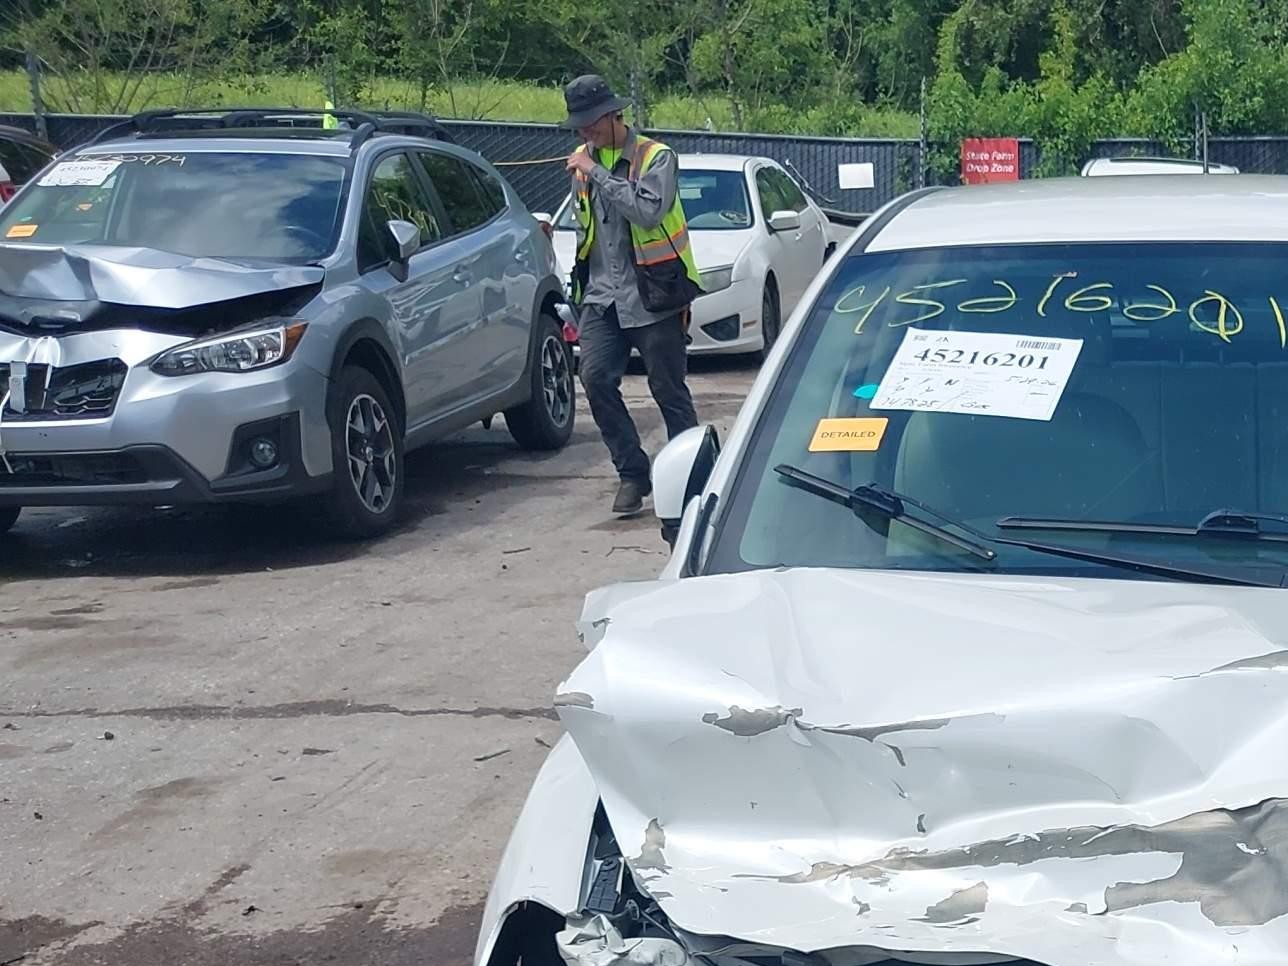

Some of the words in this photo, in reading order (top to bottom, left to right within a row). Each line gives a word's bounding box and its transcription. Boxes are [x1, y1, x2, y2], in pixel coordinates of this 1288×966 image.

[966, 152, 989, 161] State
[991, 151, 1014, 161] Farm
[966, 163, 989, 173] Drop
[991, 163, 1014, 173] Zone
[833, 275, 1287, 349] 45216201
[914, 348, 1050, 370] 45216201
[820, 431, 876, 439] DETAILED
